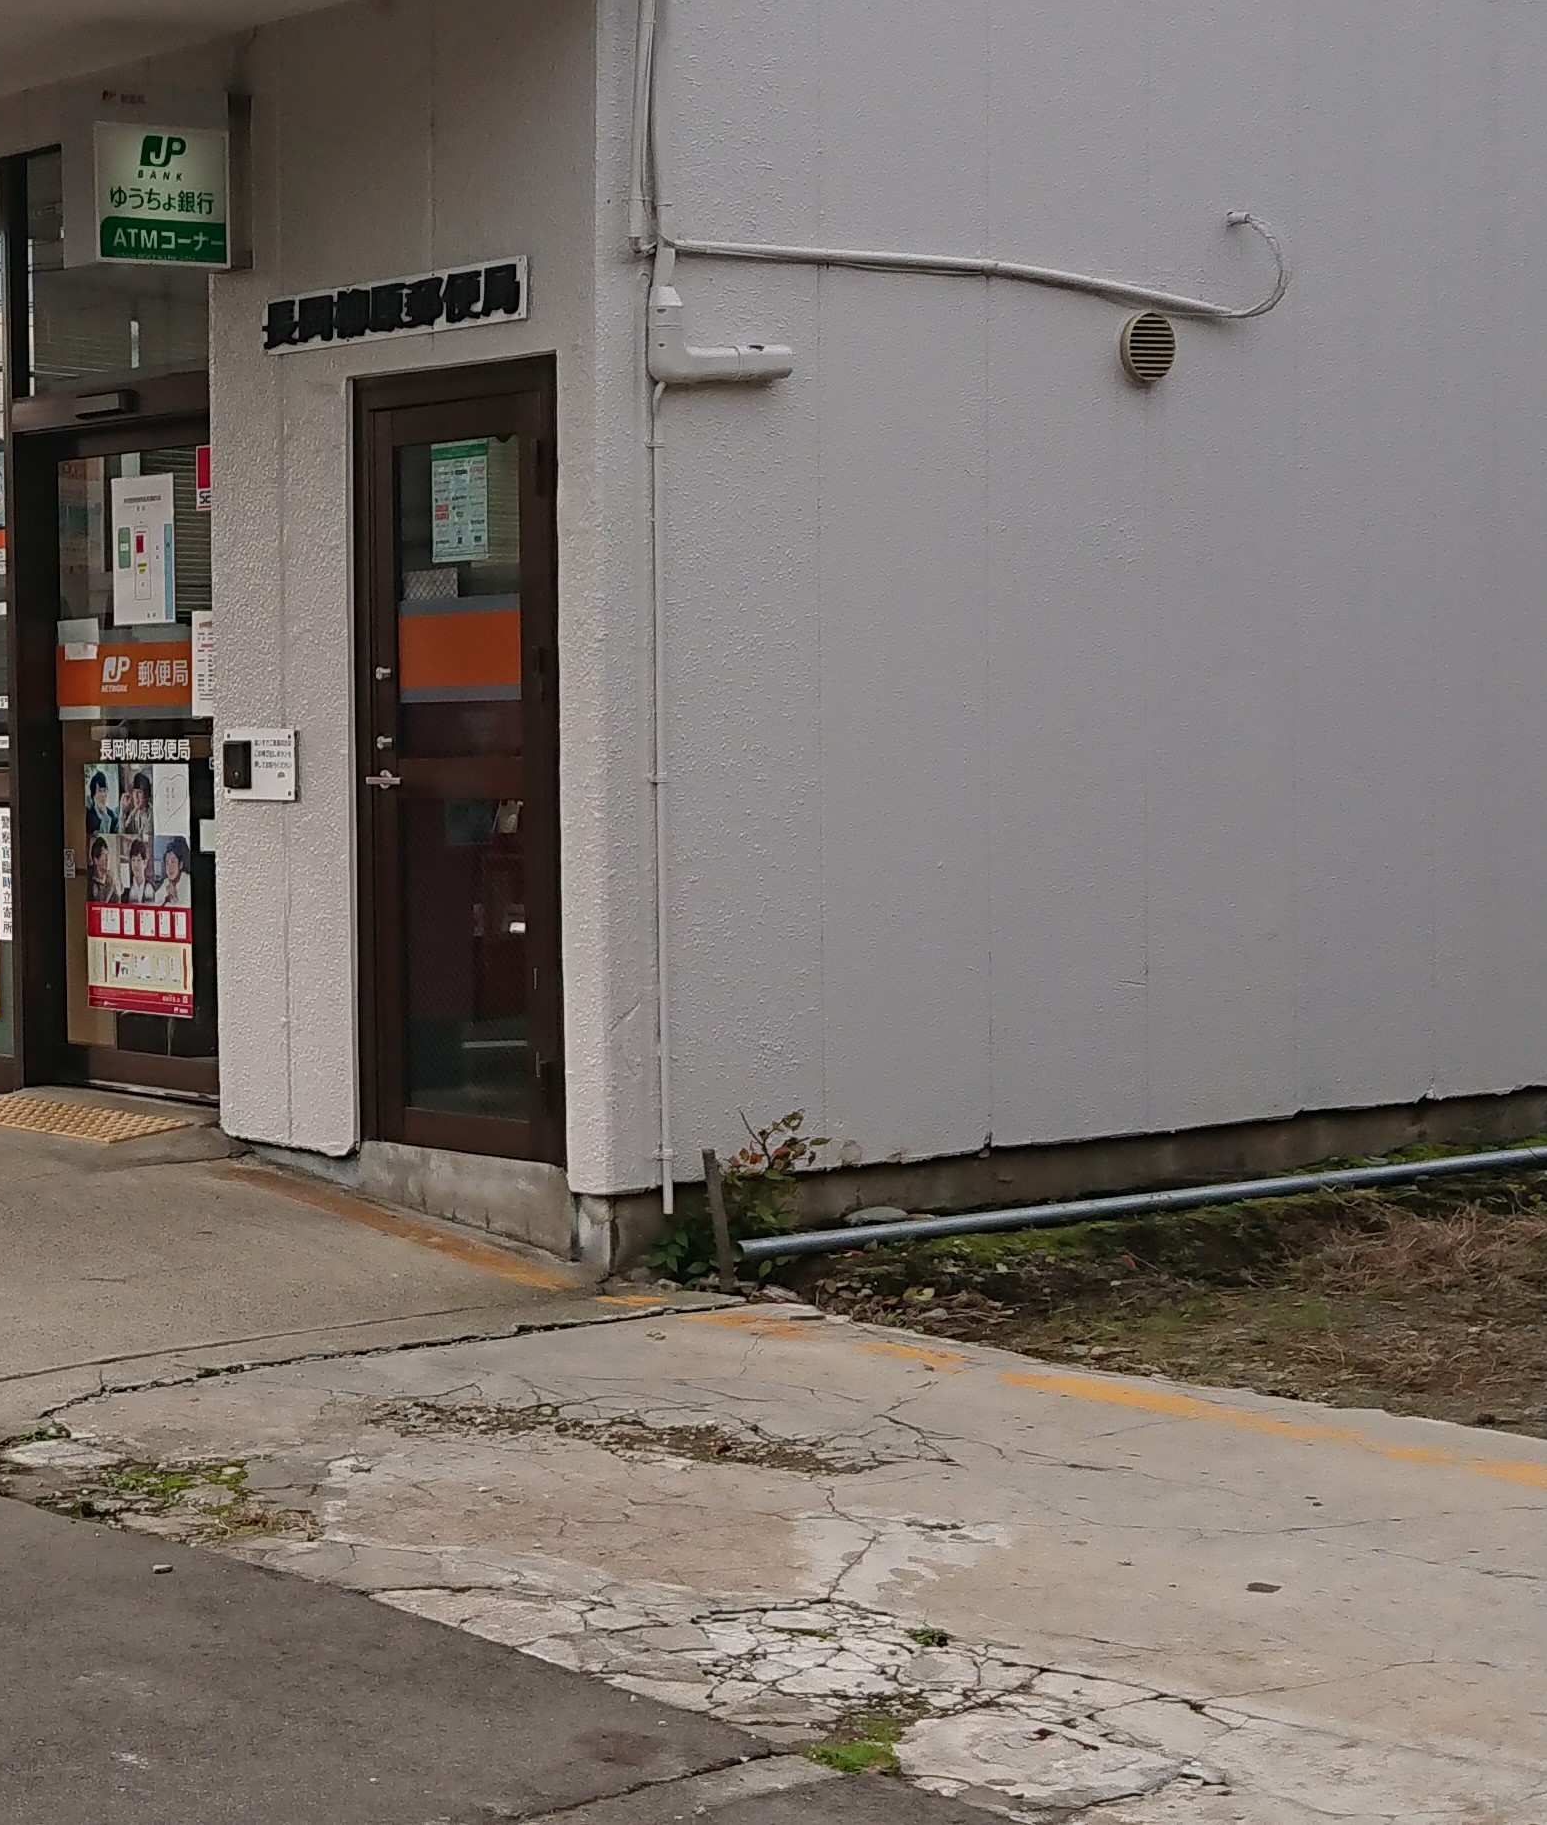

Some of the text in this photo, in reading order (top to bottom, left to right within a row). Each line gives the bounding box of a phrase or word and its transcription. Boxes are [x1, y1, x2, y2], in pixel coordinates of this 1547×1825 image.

[137, 170, 183, 182] BANK
[110, 186, 214, 215] ゆうちょ銀行
[113, 227, 225, 252] ATMコーナー
[137, 659, 189, 688] 郵便局
[100, 738, 191, 761] 長岡柳原郵便局
